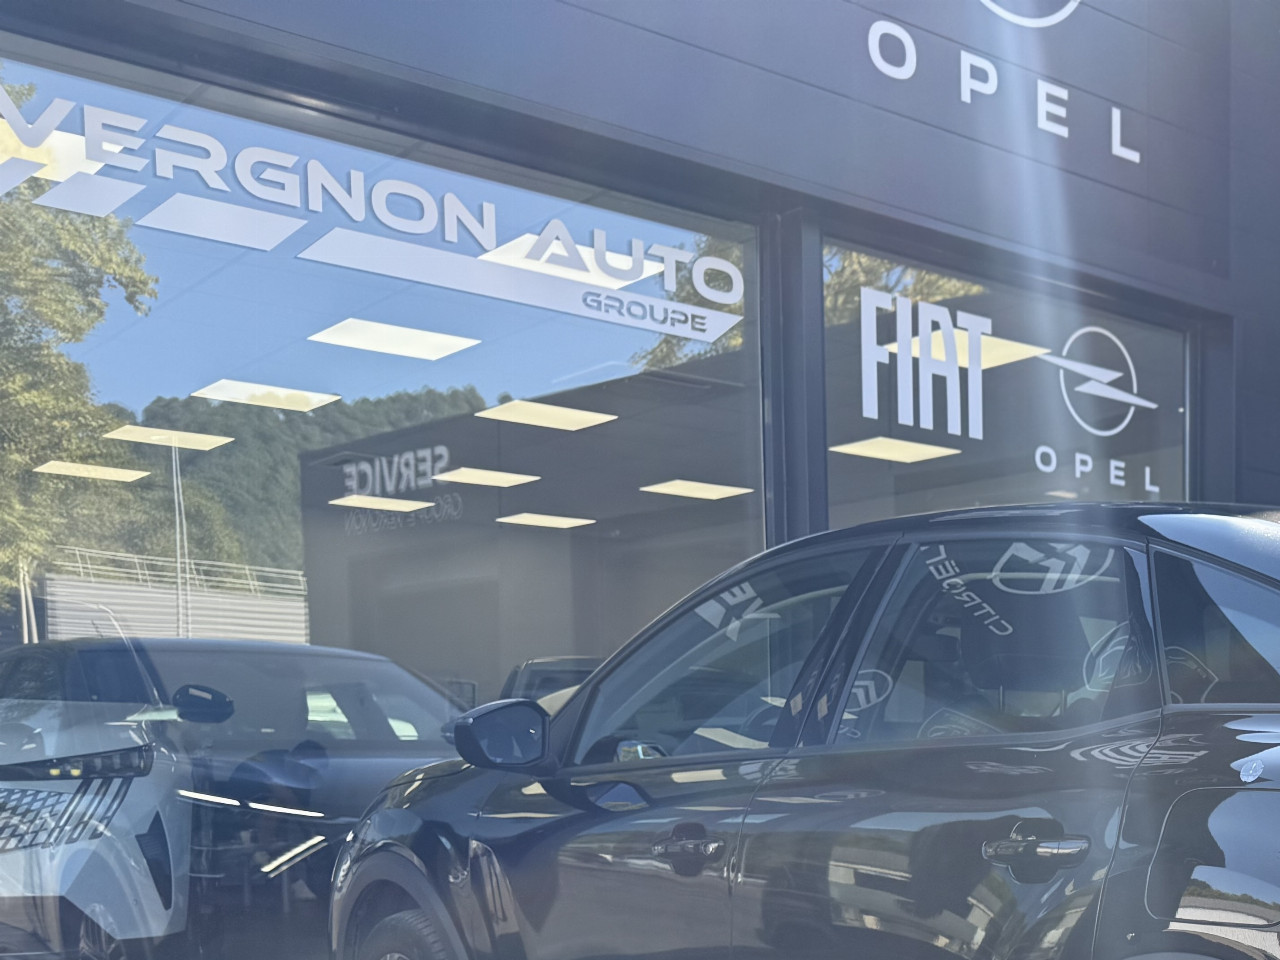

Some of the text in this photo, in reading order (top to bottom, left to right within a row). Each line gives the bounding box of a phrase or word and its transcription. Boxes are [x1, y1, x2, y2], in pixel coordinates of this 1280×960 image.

[867, 19, 1140, 164] OPEL
[0, 84, 745, 303] VERGNON AUTO
[581, 290, 709, 334] GROUPE
[860, 286, 993, 440] FIAT
[1035, 445, 1160, 493] OPEL
